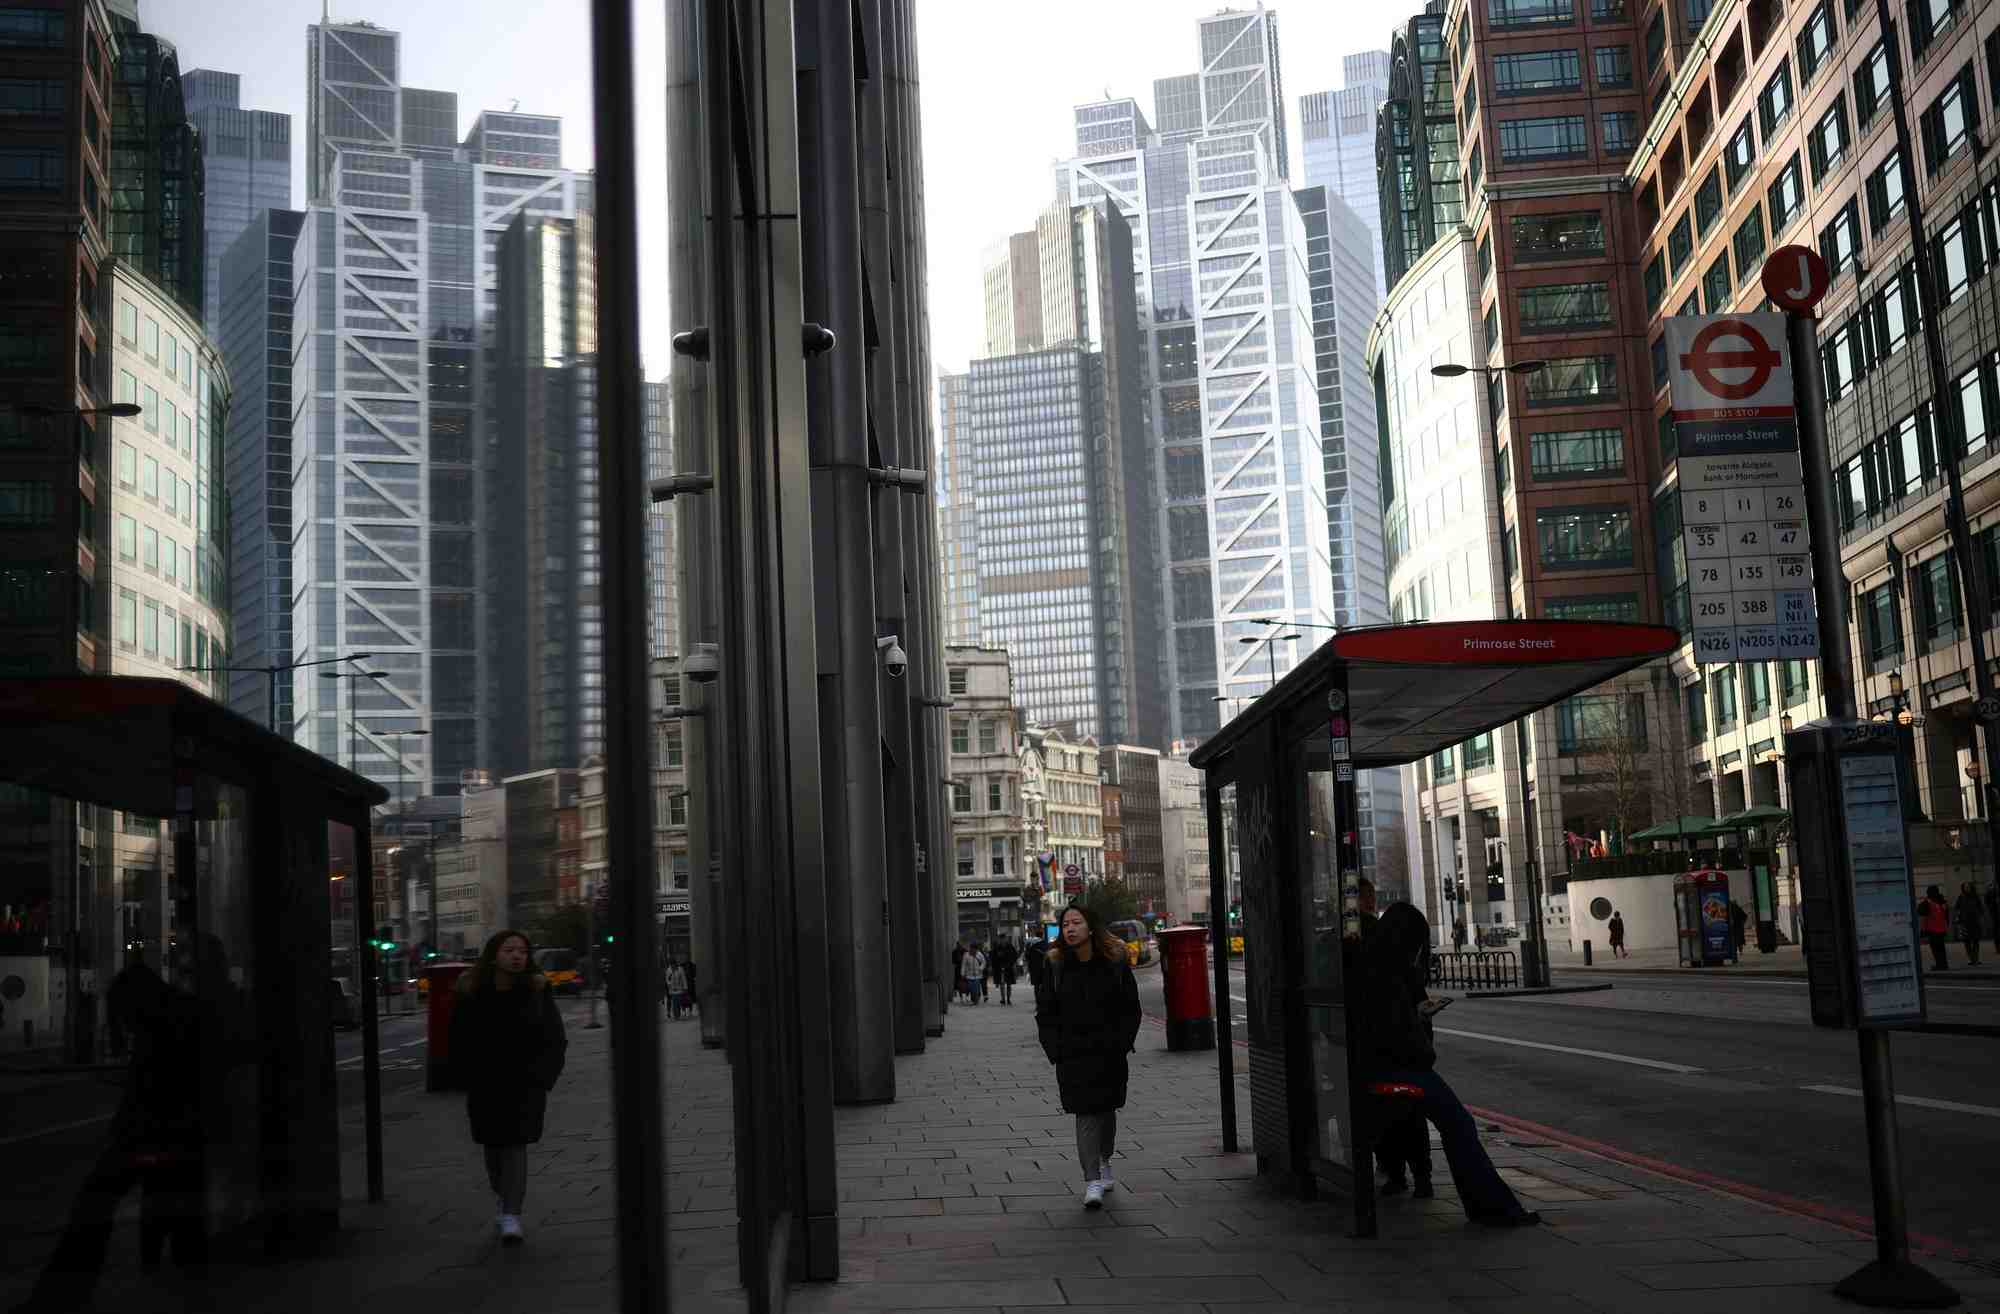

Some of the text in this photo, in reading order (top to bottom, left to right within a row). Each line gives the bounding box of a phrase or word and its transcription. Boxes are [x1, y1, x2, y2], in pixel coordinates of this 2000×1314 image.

[1785, 255, 1811, 300] J
[1713, 407, 1760, 418] BUS STOP
[1695, 429, 1780, 443] Primrose Street
[1698, 500, 1707, 513] 8
[1738, 498, 1751, 511] 11
[1776, 496, 1793, 509] 26
[1698, 534, 1715, 546] 35
[1741, 531, 1757, 544] 42
[1781, 531, 1797, 543] 47
[1701, 569, 1718, 581] 78
[1739, 566, 1763, 579] 135
[1780, 565, 1803, 577] 149
[1700, 603, 1725, 616] 205
[1741, 600, 1768, 613] 388
[1786, 599, 1803, 610] N8
[1785, 611, 1808, 622] N11
[1463, 638, 1556, 649] Primrose Street
[1700, 639, 1730, 651] N26
[1739, 636, 1775, 648] N205
[1780, 635, 1815, 647] N242
